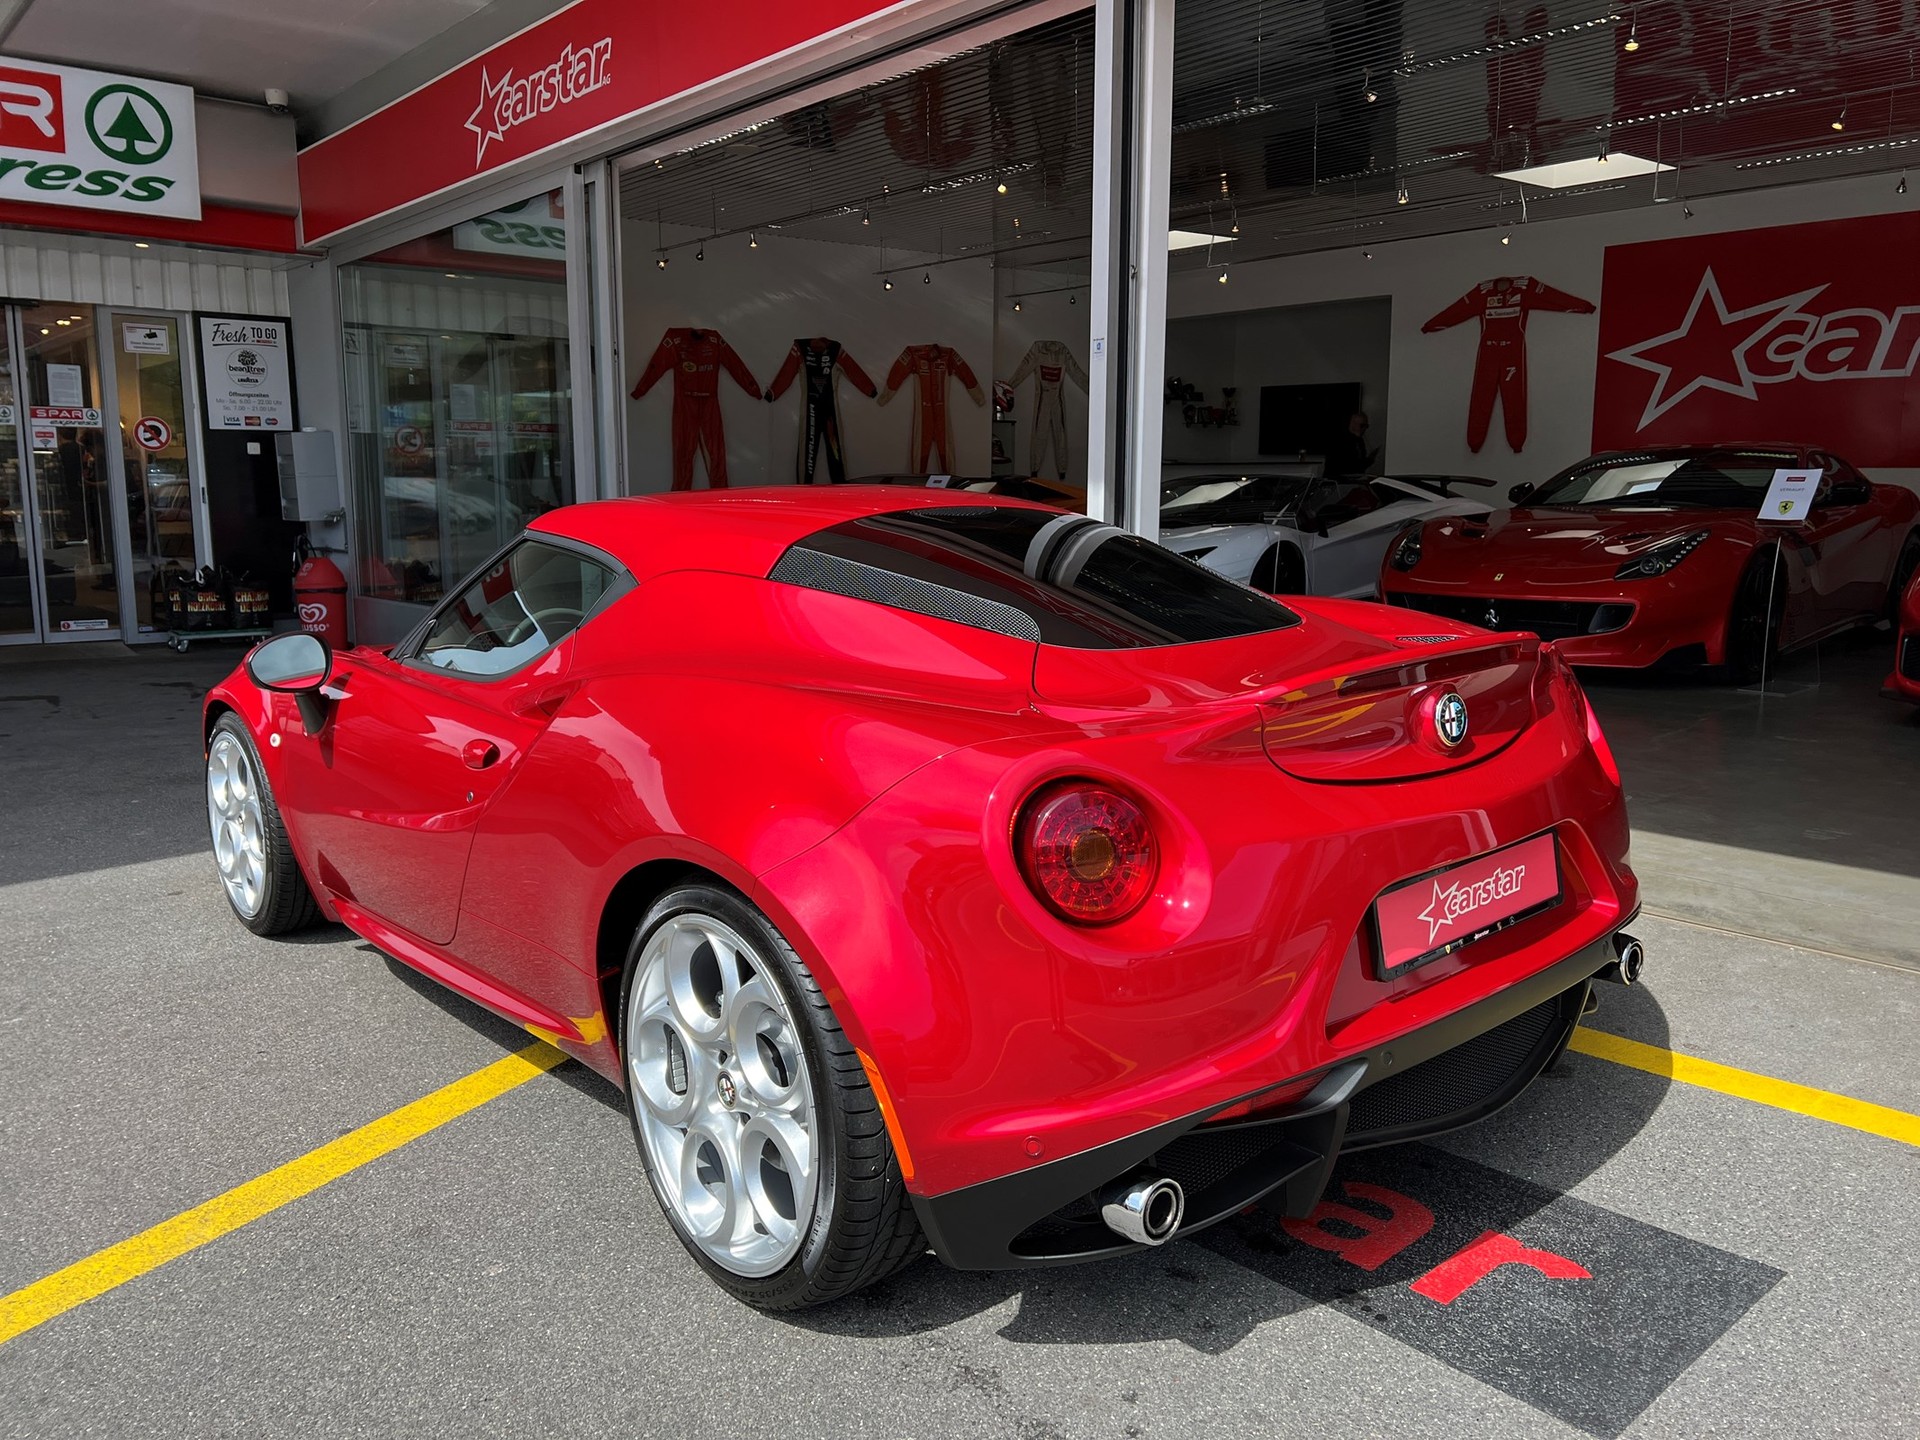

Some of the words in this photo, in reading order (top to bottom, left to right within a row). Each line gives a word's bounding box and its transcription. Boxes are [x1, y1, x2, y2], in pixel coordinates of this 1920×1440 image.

[499, 37, 612, 131] carstar
[211, 322, 249, 343] Fresh
[250, 327, 263, 339] TO
[265, 328, 277, 340] GO
[36, 409, 83, 418] SPAR
[1447, 865, 1526, 918] carstar
